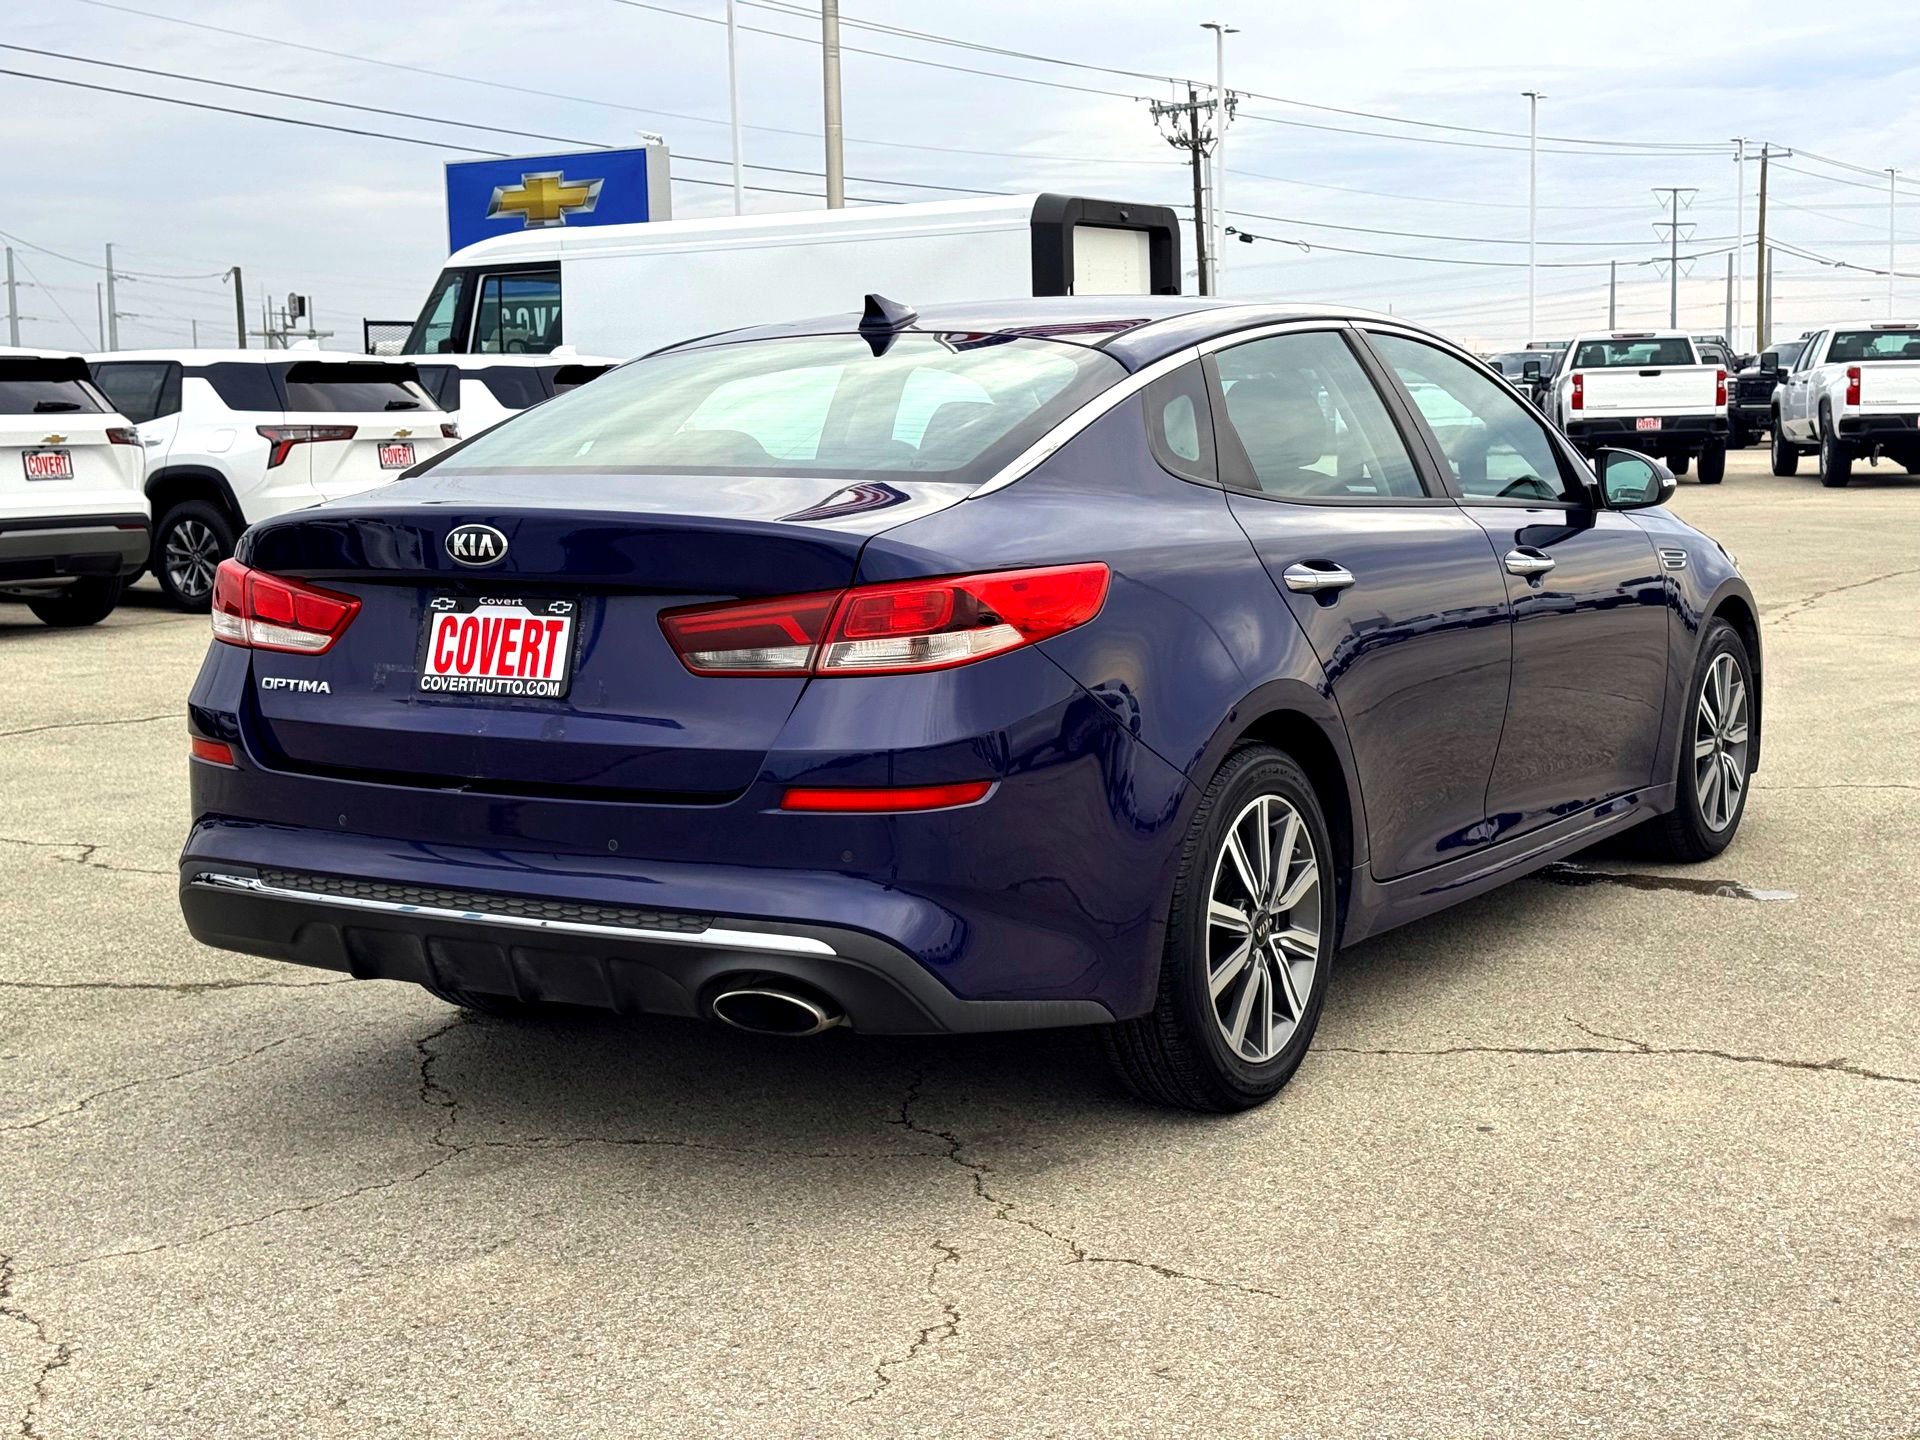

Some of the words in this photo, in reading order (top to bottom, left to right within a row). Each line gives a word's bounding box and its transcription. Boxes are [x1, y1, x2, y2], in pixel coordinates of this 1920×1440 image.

[501, 306, 560, 336] COV
[1638, 419, 1659, 429] COVERT
[28, 456, 66, 474] COVERT
[383, 448, 411, 465] COVERT
[453, 534, 496, 556] KIA
[479, 597, 523, 606] Covert
[435, 616, 564, 678] COVERT
[262, 677, 331, 694] OPTIMA
[421, 676, 560, 697] COVERTHUTTO.COM
